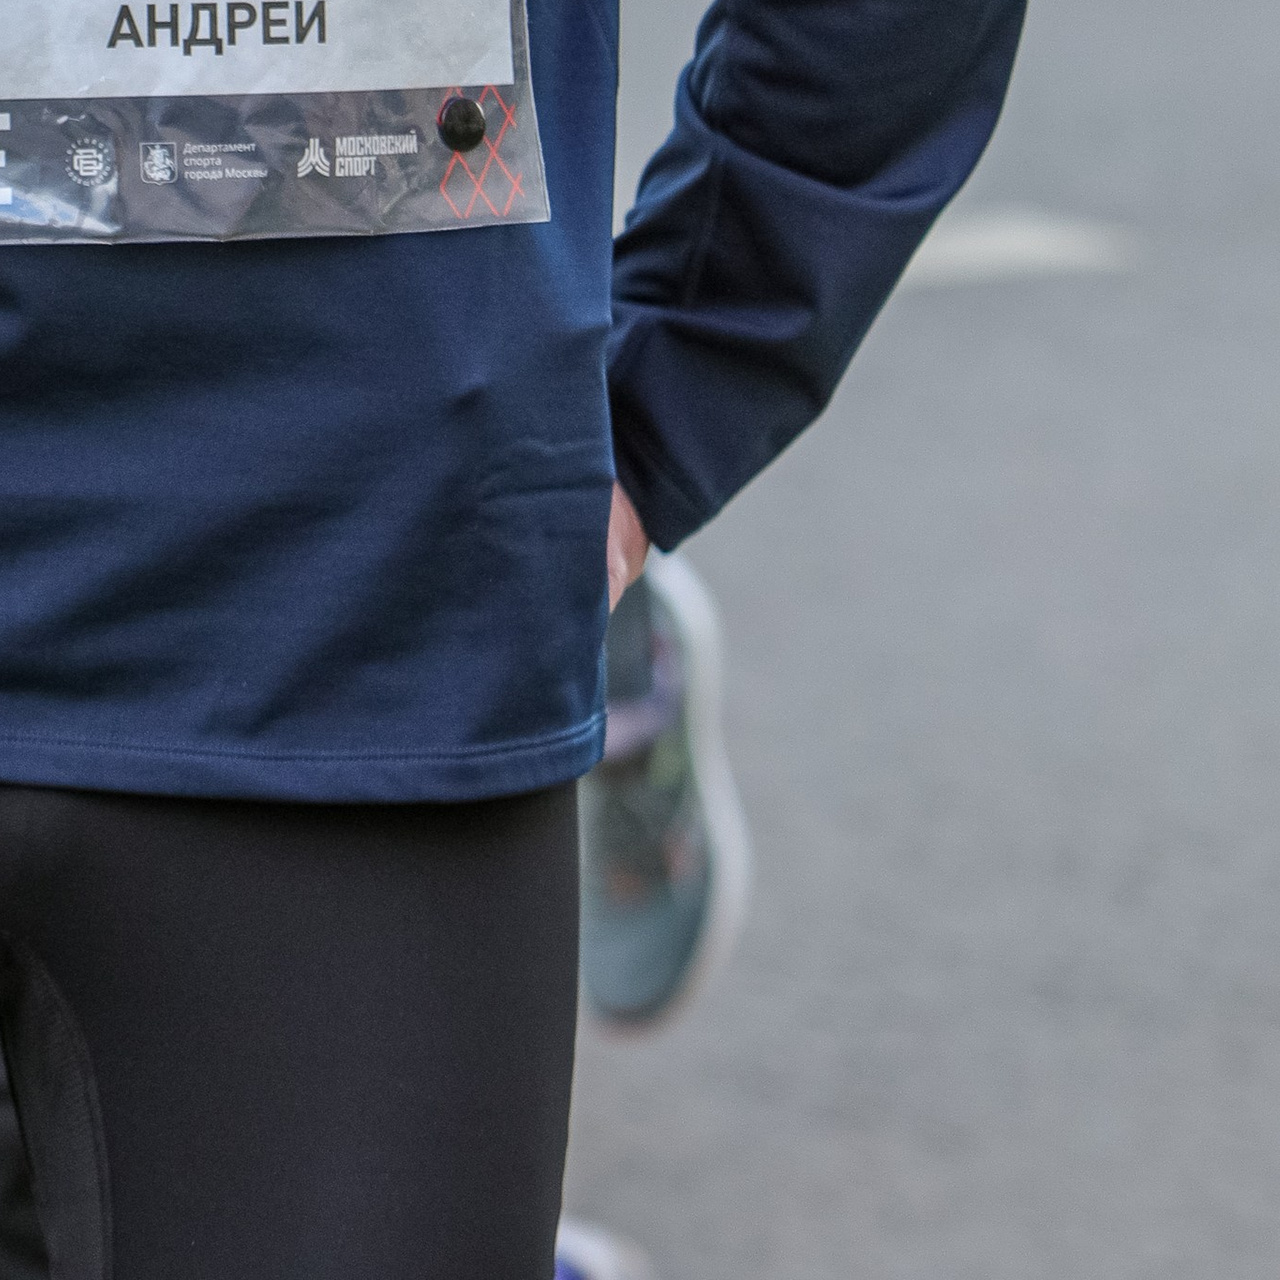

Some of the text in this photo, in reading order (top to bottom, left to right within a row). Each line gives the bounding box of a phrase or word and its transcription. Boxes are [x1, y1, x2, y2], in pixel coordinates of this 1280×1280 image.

[183, 143, 256, 155] Департамент
[335, 129, 418, 156] МОСКОВСКИЙ
[183, 157, 222, 168] спорта
[335, 156, 377, 177] СПОРТ
[184, 168, 268, 181] города Москвы
